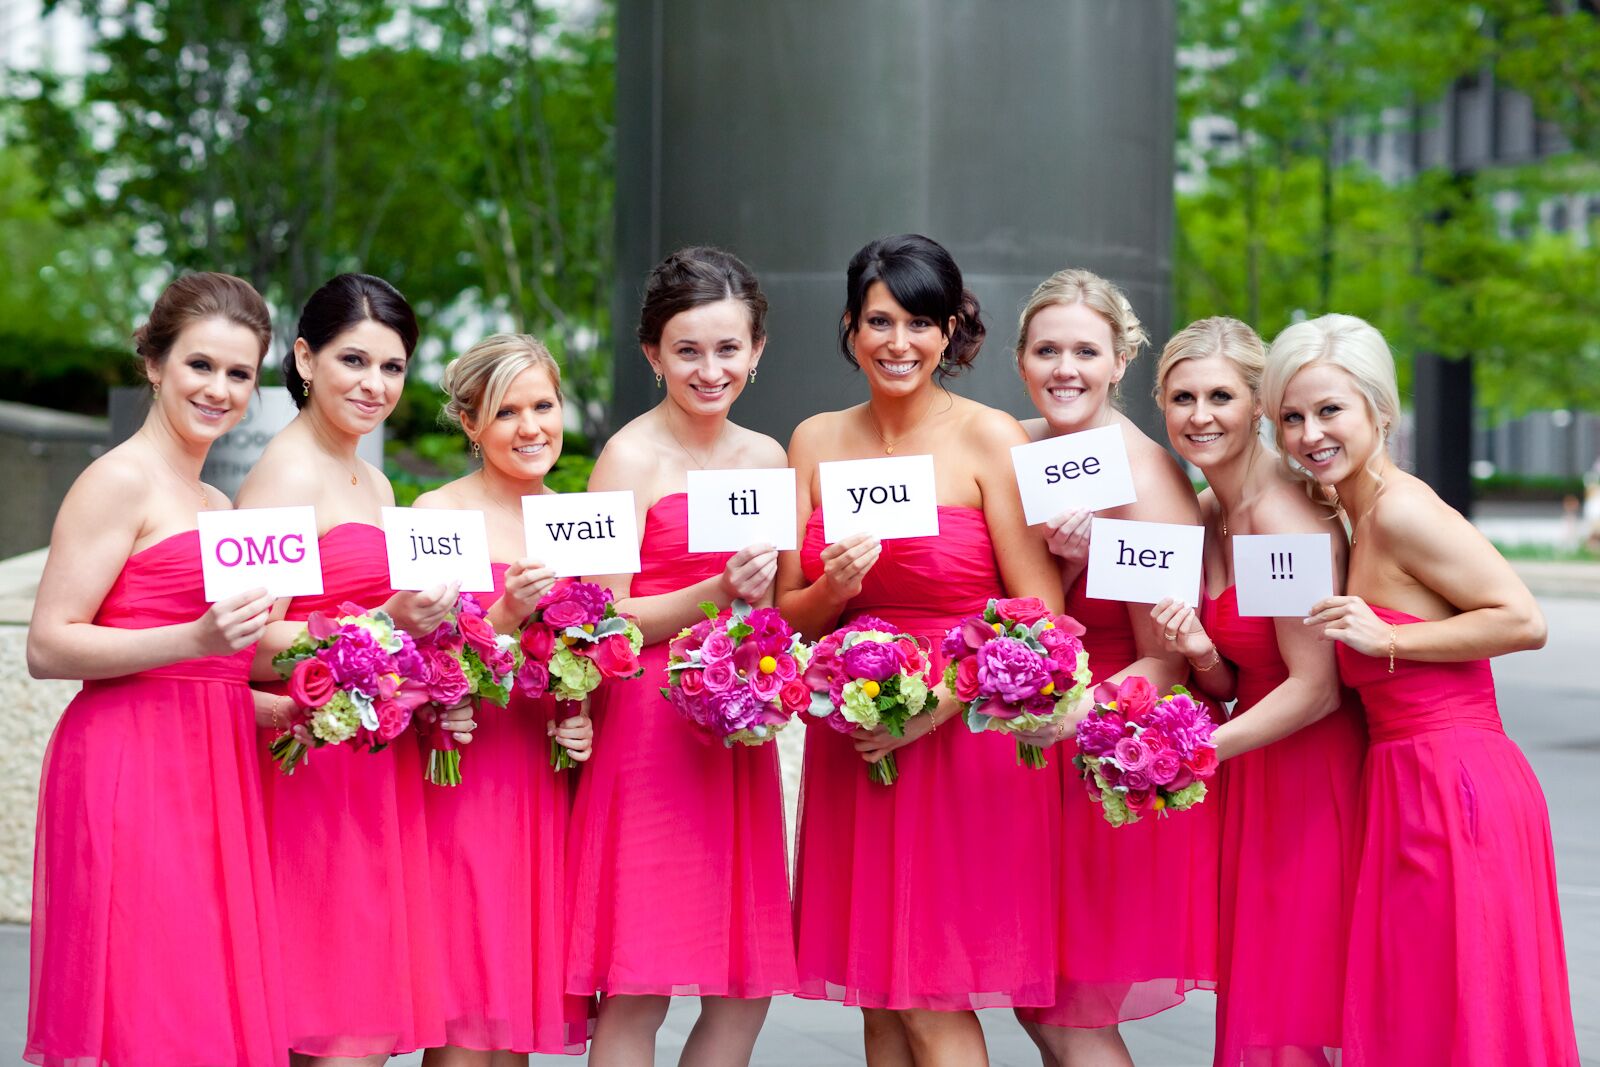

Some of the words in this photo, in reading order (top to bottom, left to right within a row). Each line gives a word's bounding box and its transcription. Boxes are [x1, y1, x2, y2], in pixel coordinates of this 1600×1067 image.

[1044, 456, 1102, 485] see
[728, 489, 760, 516] til
[847, 484, 911, 514] you
[545, 514, 617, 542] wait
[215, 533, 306, 568] OMG
[409, 528, 463, 561] just
[1115, 539, 1175, 569] her
[1270, 552, 1294, 580] !!!
